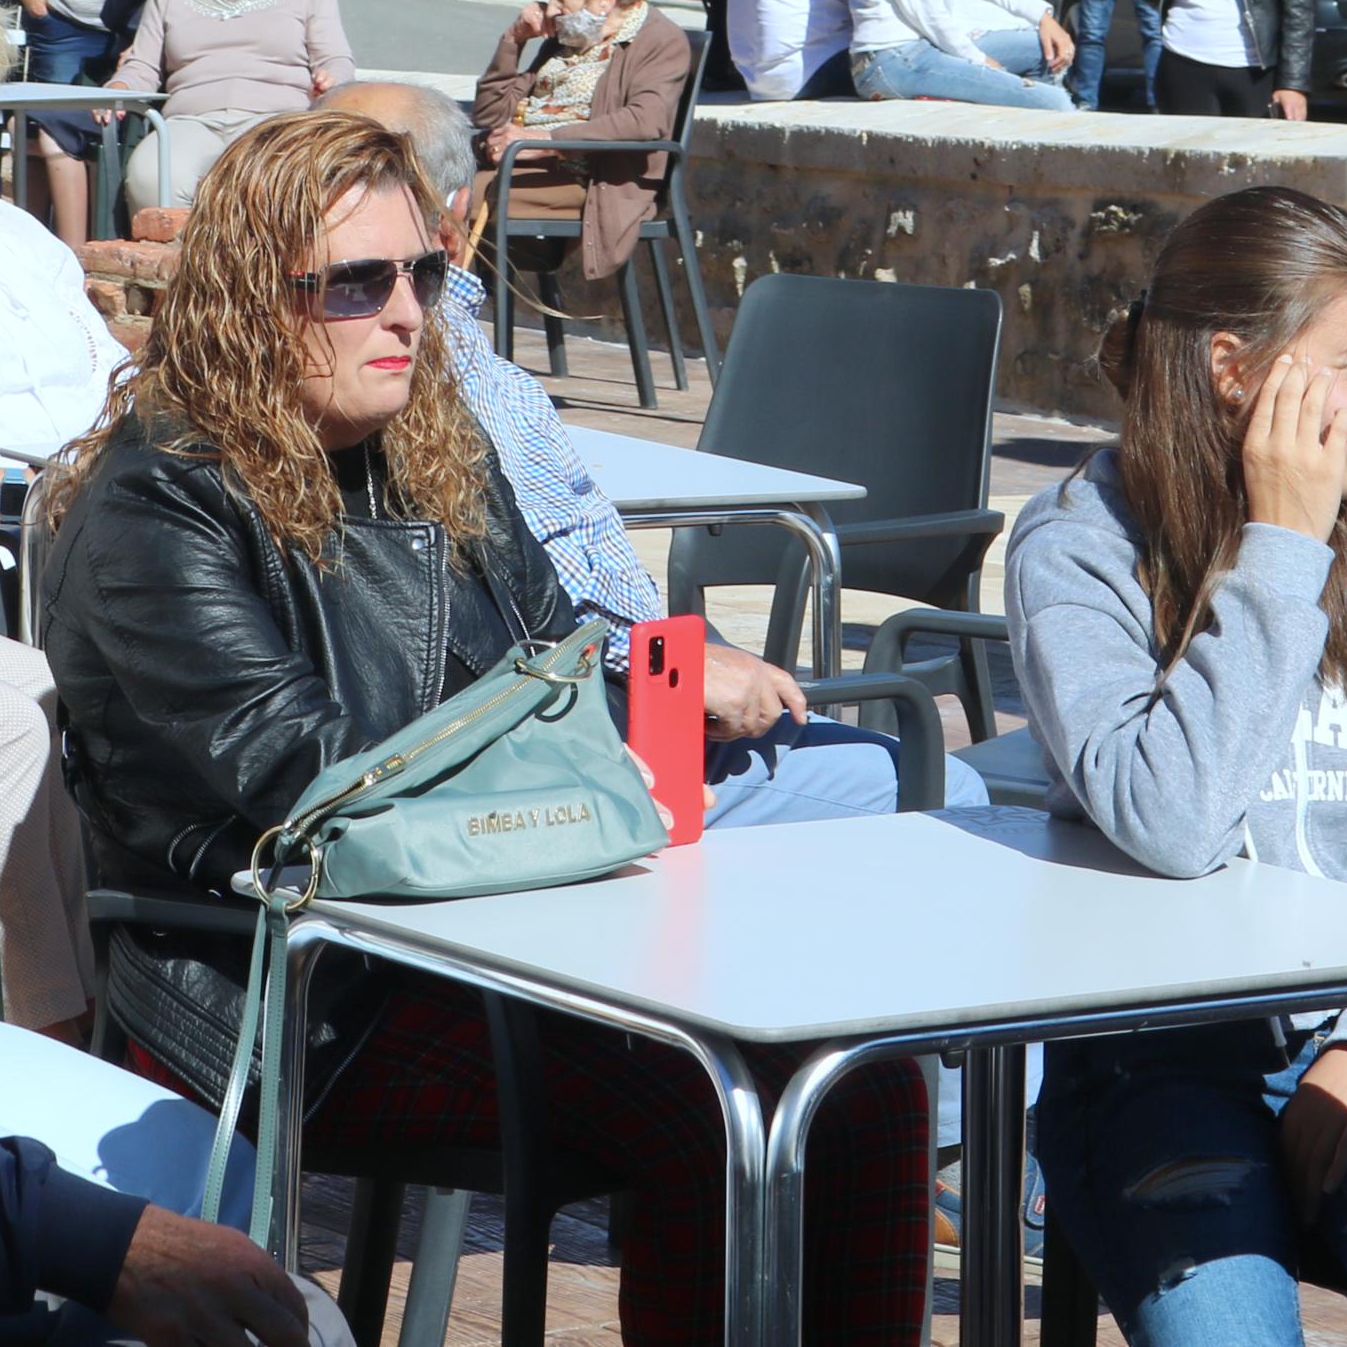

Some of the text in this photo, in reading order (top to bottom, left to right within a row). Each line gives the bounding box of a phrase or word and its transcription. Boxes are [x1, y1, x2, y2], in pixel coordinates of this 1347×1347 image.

[467, 803, 592, 837] BIMBA Y LOLA
